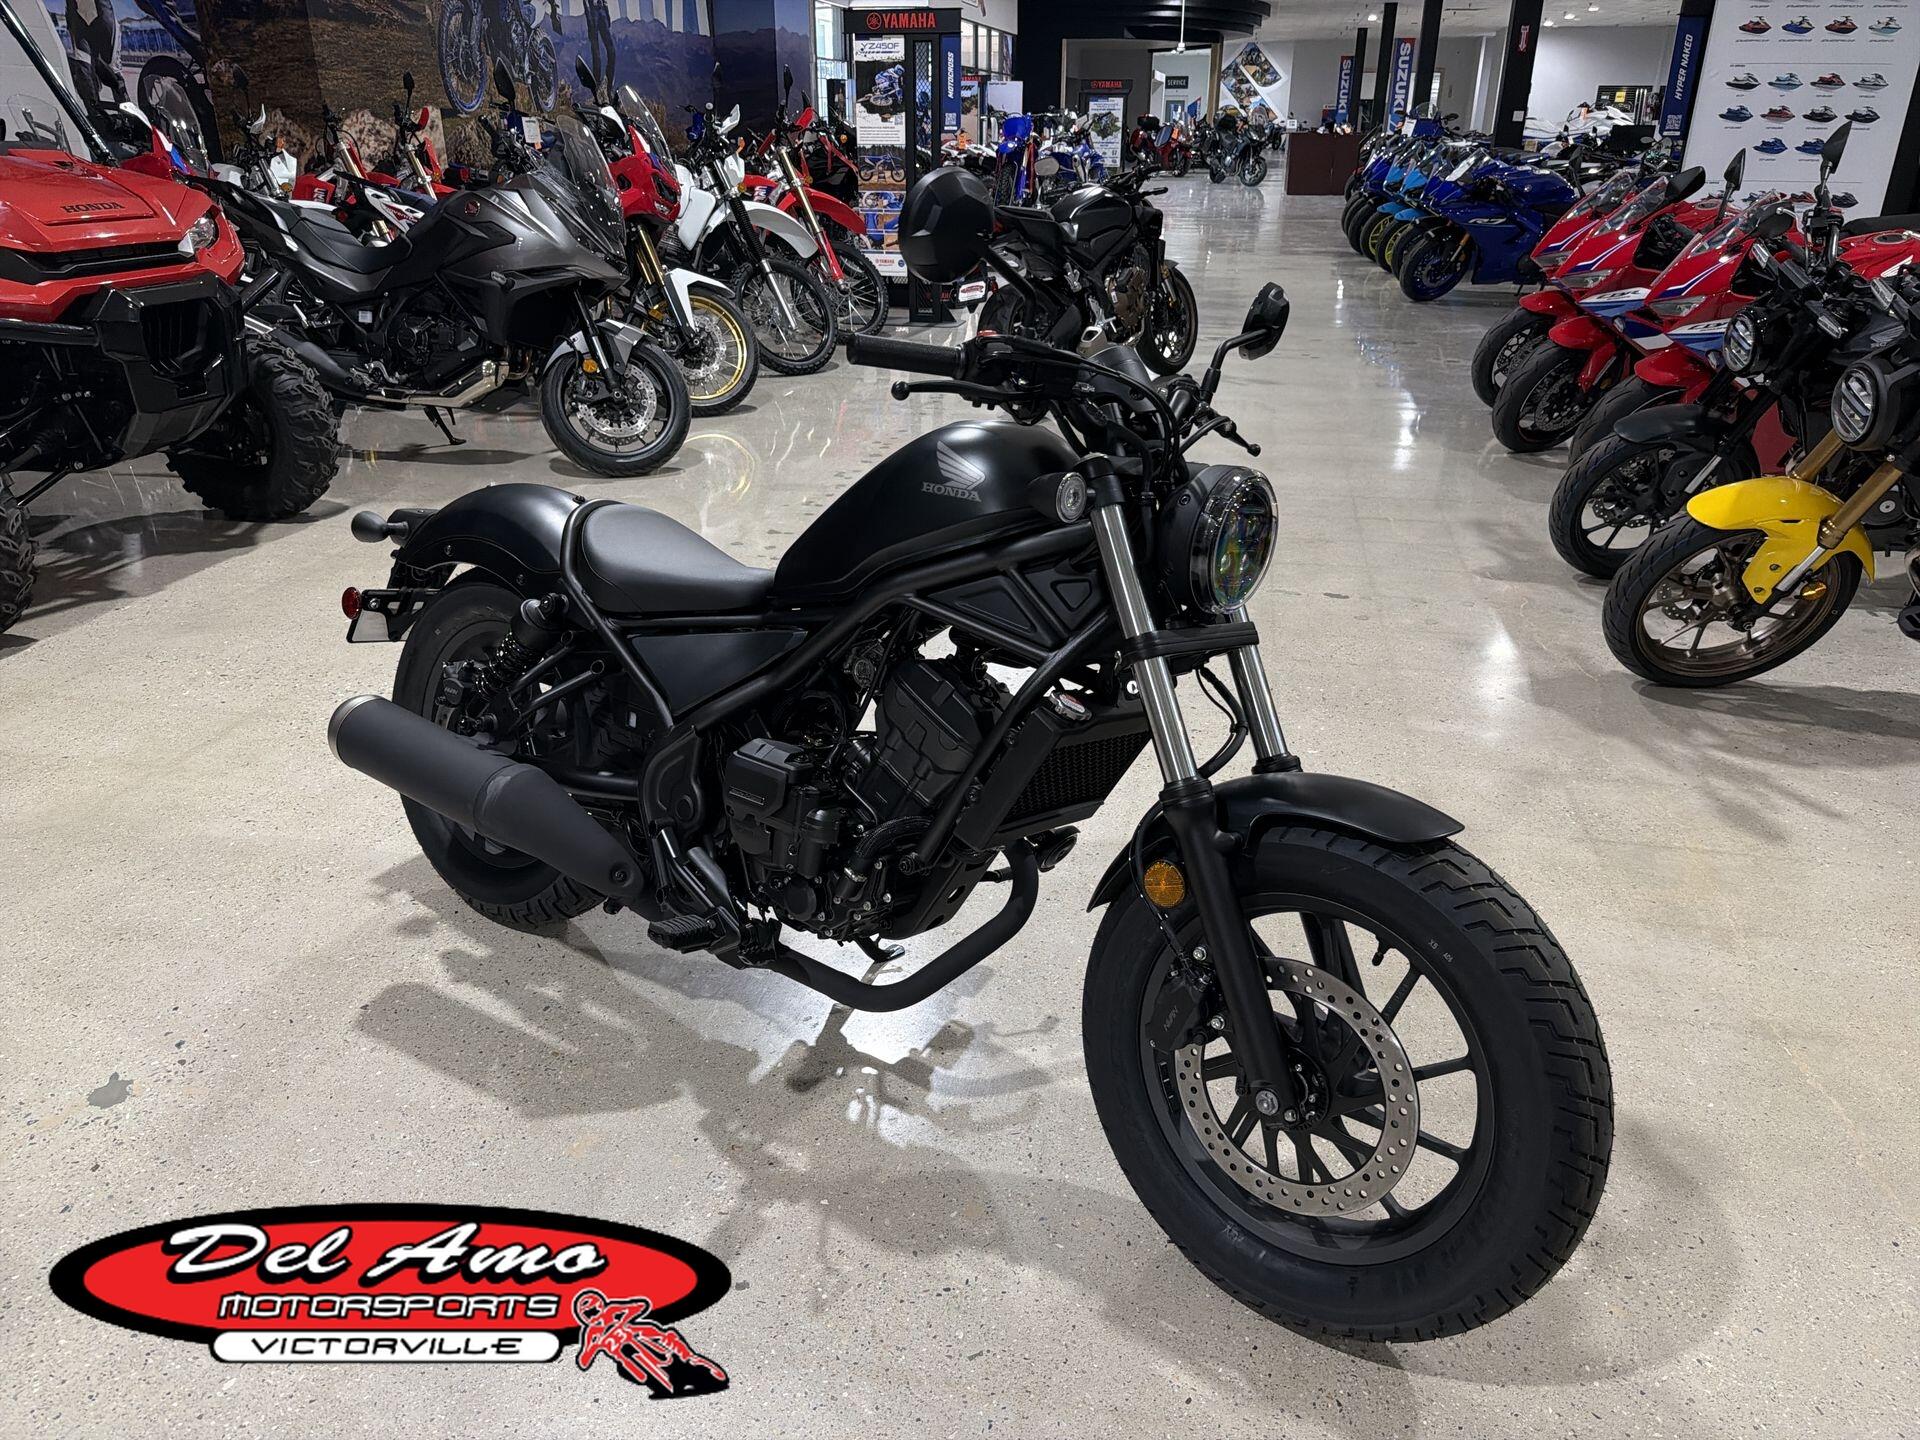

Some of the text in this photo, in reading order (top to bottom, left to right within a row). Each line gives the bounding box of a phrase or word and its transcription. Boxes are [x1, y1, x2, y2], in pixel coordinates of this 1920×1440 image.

[882, 12, 936, 28] YAMAHA
[861, 42, 900, 50] YZ450F
[947, 51, 955, 99] MOTOCROSS
[1674, 33, 1694, 100] HYPER NAKED
[1098, 80, 1122, 89] YAMAHA
[1338, 59, 1352, 113] SUZUKI
[1393, 42, 1411, 114] SUZUKI
[60, 202, 125, 213] HONDA
[921, 481, 981, 502] HONDA
